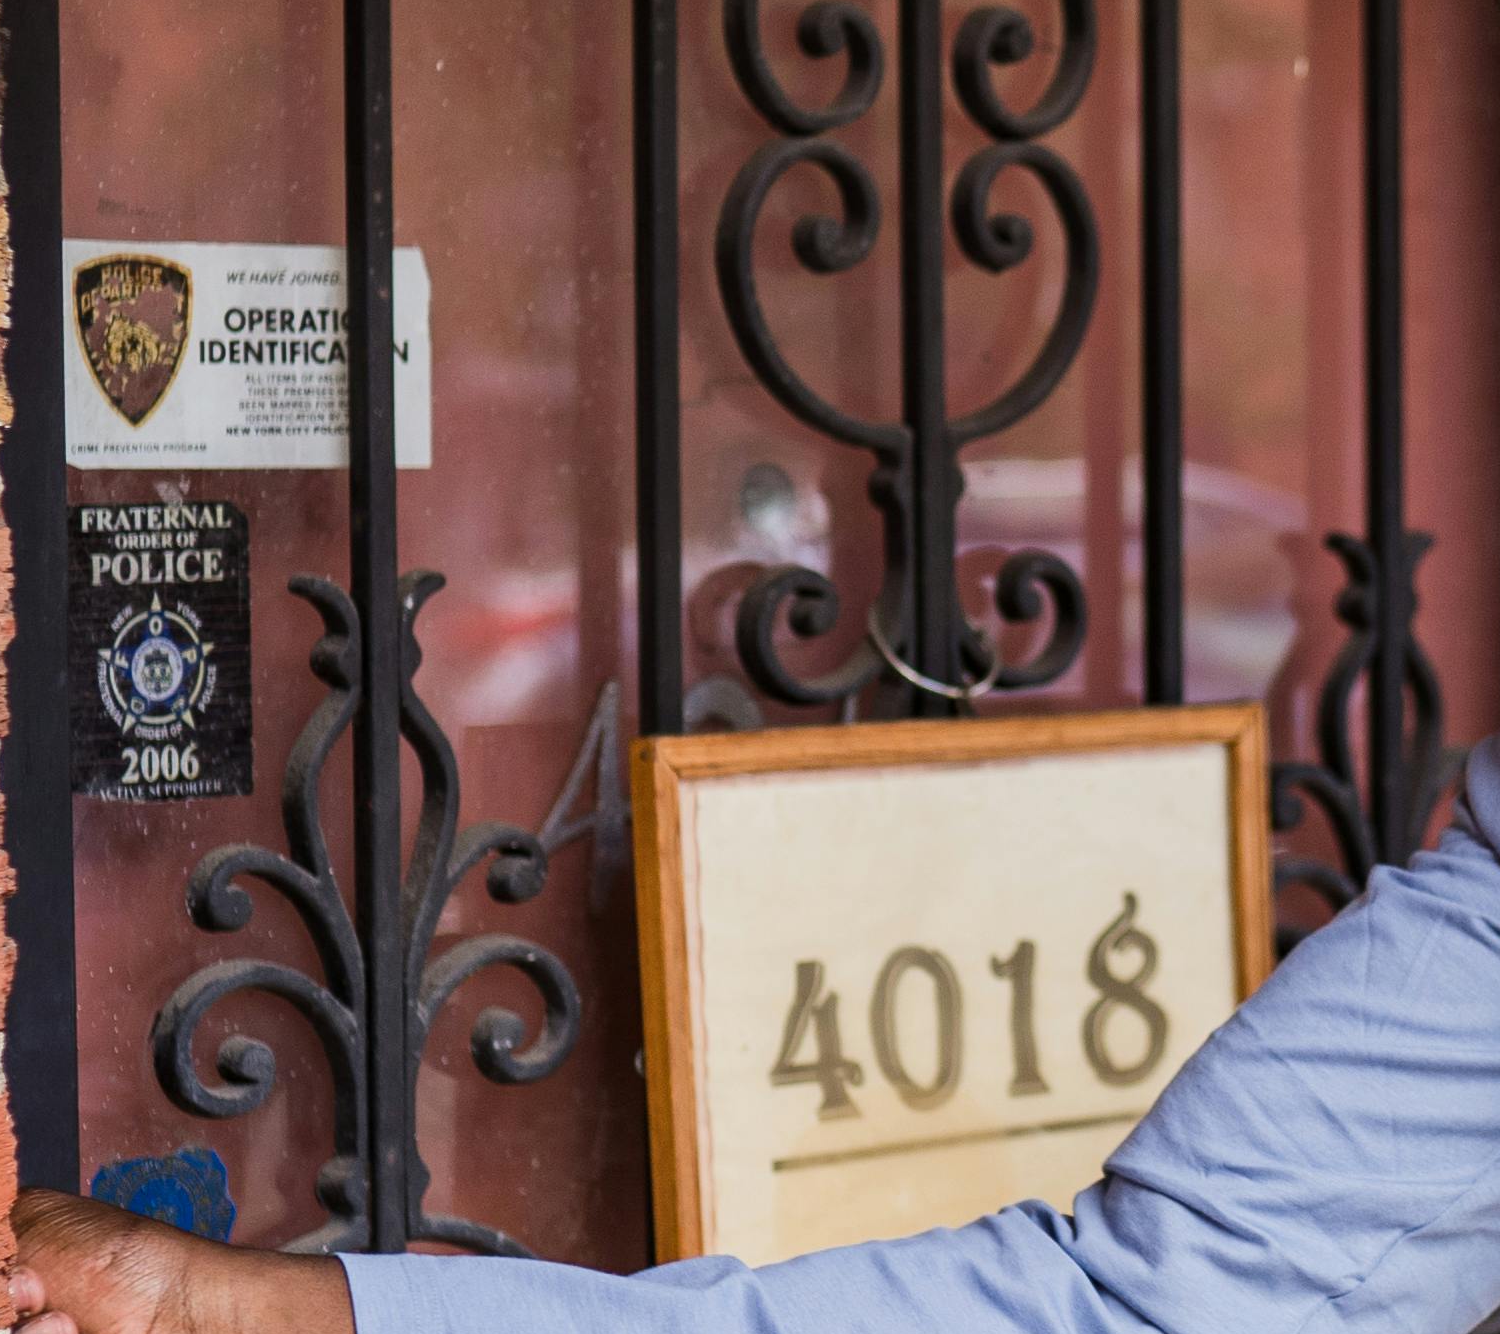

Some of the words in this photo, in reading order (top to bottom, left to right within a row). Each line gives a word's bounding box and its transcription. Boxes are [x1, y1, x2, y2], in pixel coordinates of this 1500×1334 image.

[226, 272, 245, 284] WE
[249, 271, 284, 284] HAVE
[291, 272, 339, 285] JOINED
[223, 308, 349, 333] OPERATI
[200, 340, 409, 364] IDENTIFICAN
[226, 427, 250, 435] NEW
[254, 427, 282, 435] YORK
[285, 427, 309, 435] CITY
[71, 444, 99, 454] CRIME
[103, 443, 160, 453] PREVENTION
[163, 443, 207, 452] PROGRAM
[81, 504, 231, 533] FRATERNAL
[114, 532, 173, 549] ORDER
[176, 531, 199, 548] OF
[91, 549, 224, 587] POLICE
[177, 600, 202, 630] YORK
[135, 724, 169, 740] ORDER
[170, 722, 183, 738] OF
[121, 742, 200, 784] 2006
[149, 779, 222, 797] SUPPORTER
[769, 890, 1170, 1122] 4018
